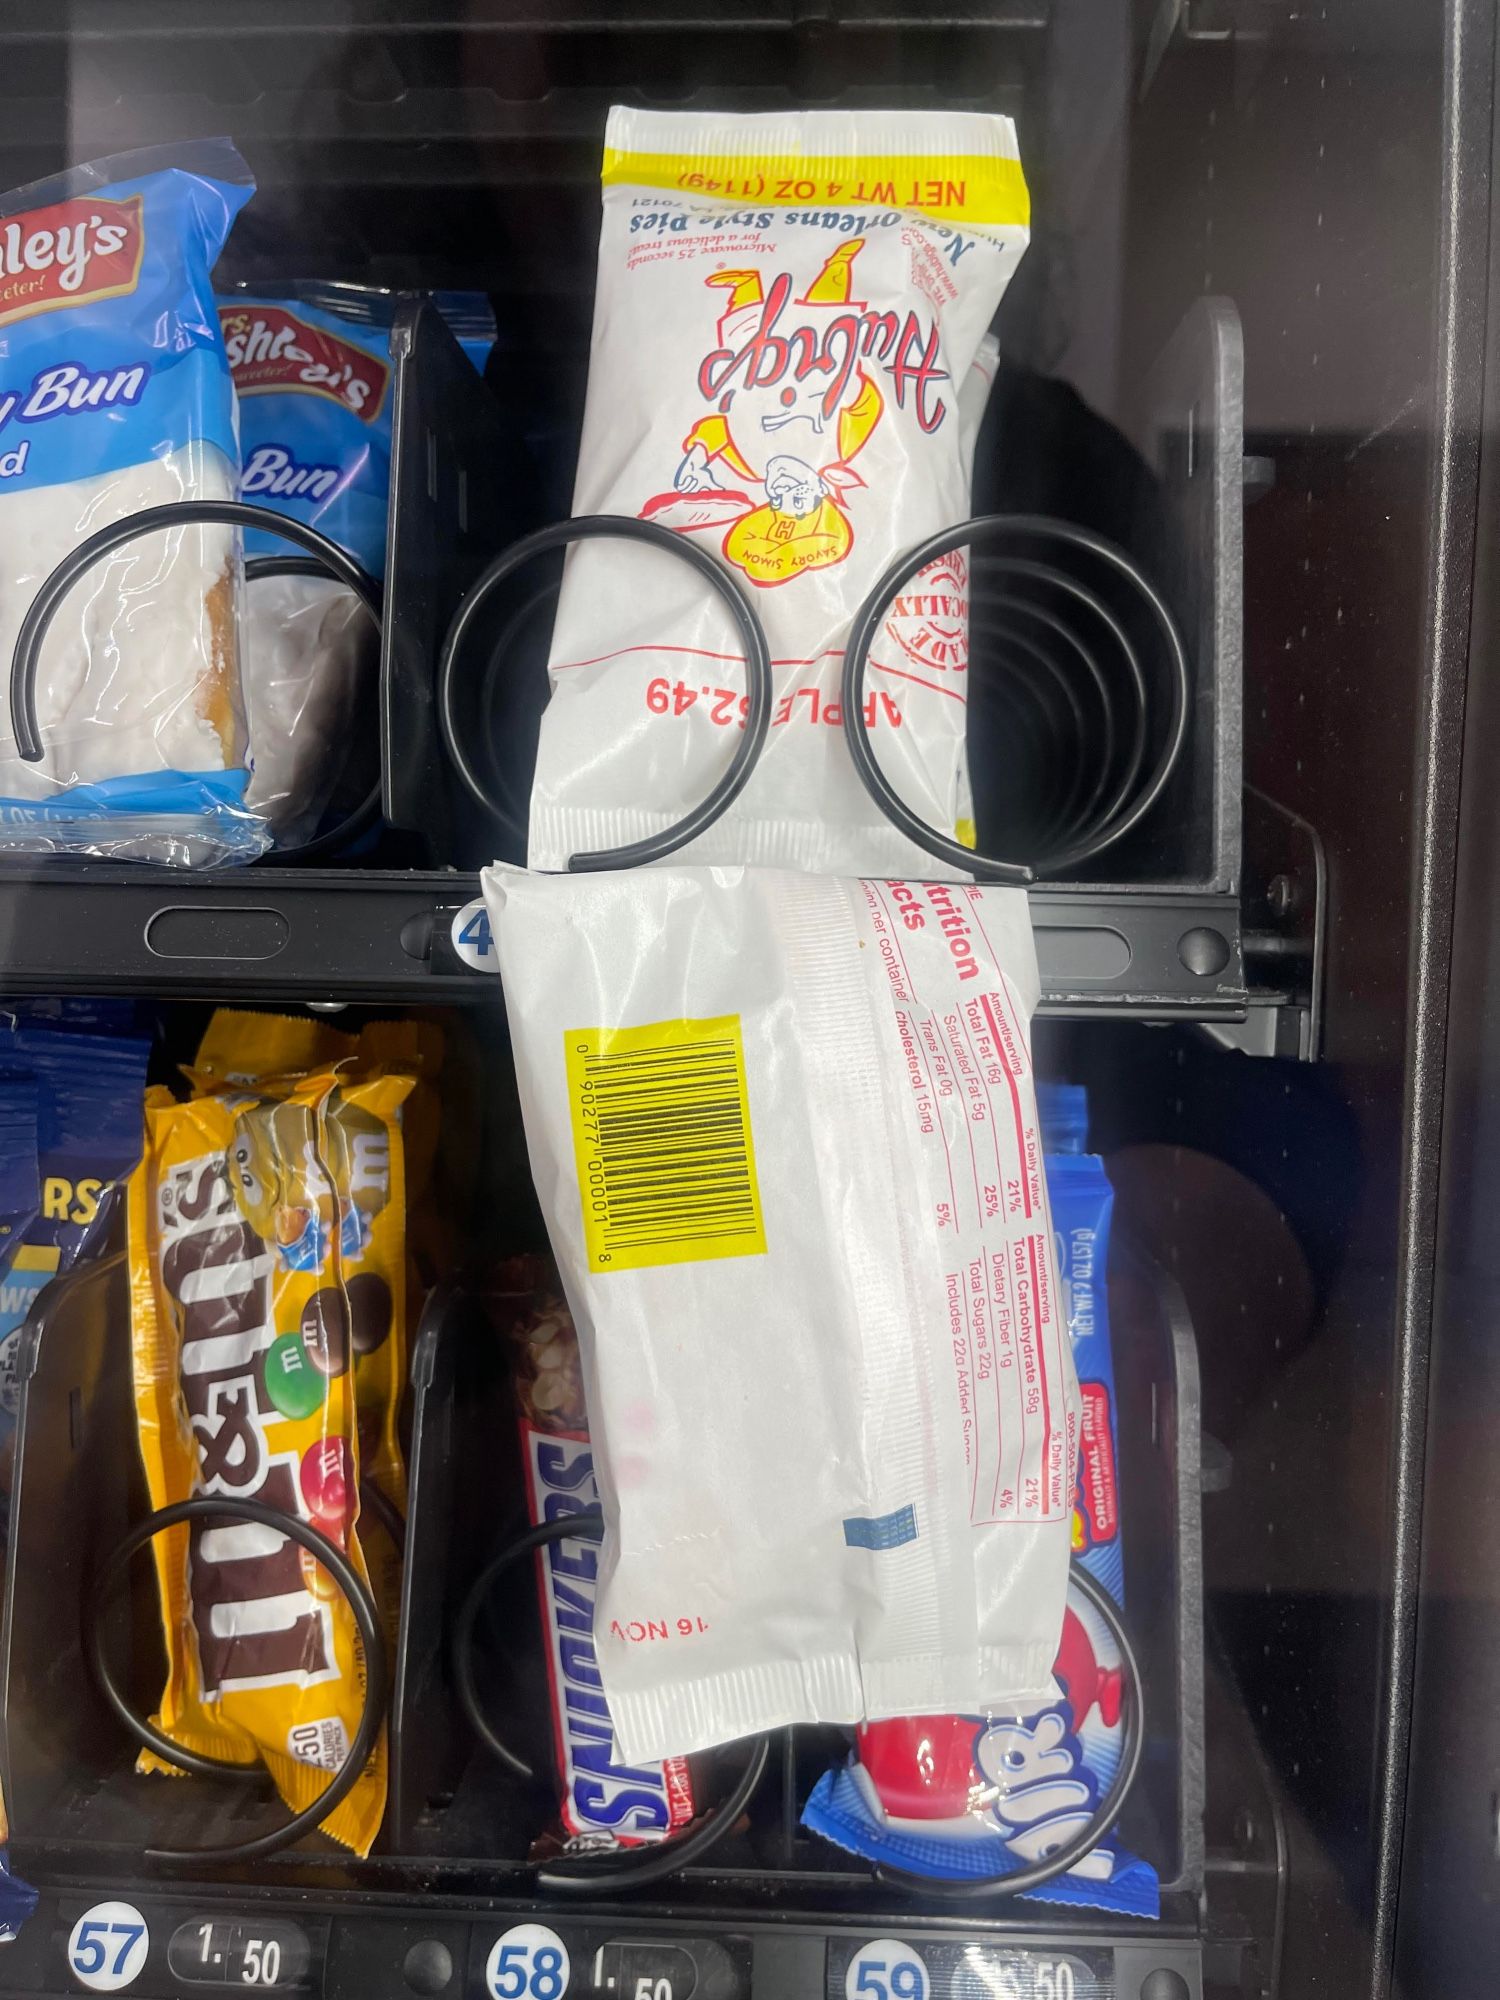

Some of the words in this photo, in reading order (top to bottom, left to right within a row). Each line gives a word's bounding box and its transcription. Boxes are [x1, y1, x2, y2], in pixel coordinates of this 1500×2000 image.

[677, 172, 766, 198] (114g)
[773, 180, 816, 200] OZ
[827, 183, 843, 198] 4
[851, 180, 898, 206] WT
[907, 181, 966, 207] NET
[630, 212, 688, 235] Pies
[785, 210, 902, 237] Orleans
[677, 248, 696, 261] 25
[22, 366, 145, 418] Bun
[244, 449, 339, 498] Bun
[742, 549, 784, 570] SIMON
[790, 545, 838, 567] SAVORY
[891, 594, 968, 618] OCALLY
[458, 909, 494, 957] 4
[922, 882, 980, 981] trition
[879, 937, 910, 1004] container
[576, 1044, 589, 1054] 0
[919, 1019, 939, 1052] Trans
[943, 1014, 973, 1075] Saturated
[989, 991, 1023, 1077] Amount/serving
[932, 1054, 948, 1077] Fat
[938, 1080, 953, 1098] 0g
[965, 1077, 982, 1100] Fat
[965, 997, 986, 1035] Total
[976, 1036, 993, 1060] Fat
[987, 1063, 1002, 1085] 16g
[1007, 1179, 1023, 1213] 21%
[578, 1080, 600, 1145] 90277
[894, 1010, 927, 1090] Cholesterol
[916, 1094, 935, 1134] 15mg
[936, 1202, 952, 1228] 5%
[972, 1102, 987, 1122] 5g
[587, 1160, 610, 1224] 00001
[983, 1184, 1001, 1218] 25%
[598, 1253, 612, 1263] 8
[1013, 1237, 1026, 1280] Total
[1069, 1228, 1097, 1260] (57g)
[969, 1258, 982, 1296] Total
[991, 1253, 1007, 1304] Dietary
[1035, 1234, 1050, 1325] Amount/serving
[1072, 1262, 1093, 1280] OZ
[945, 1273, 962, 1336] Includes
[973, 1297, 988, 1350] Sugars
[998, 1308, 1010, 1346] Fiber
[1016, 1280, 1036, 1384] Carbohydrate
[977, 1352, 992, 1380] 22g
[1000, 1350, 1012, 1369] 1g
[1026, 1387, 1040, 1415] 58g
[1082, 1393, 1097, 1443] FRUIT
[1000, 1488, 1013, 1509] 4%
[1025, 1478, 1039, 1508] 21%
[1088, 1444, 1109, 1531] ORIGINAL
[610, 1620, 668, 1641] NOV
[676, 1616, 709, 1636] 16
[320, 1721, 337, 1770] CALORIES
[73, 1922, 145, 1975] 57
[242, 1940, 281, 1986] 50
[494, 1945, 563, 2000] 58
[855, 1961, 922, 2000] 59
